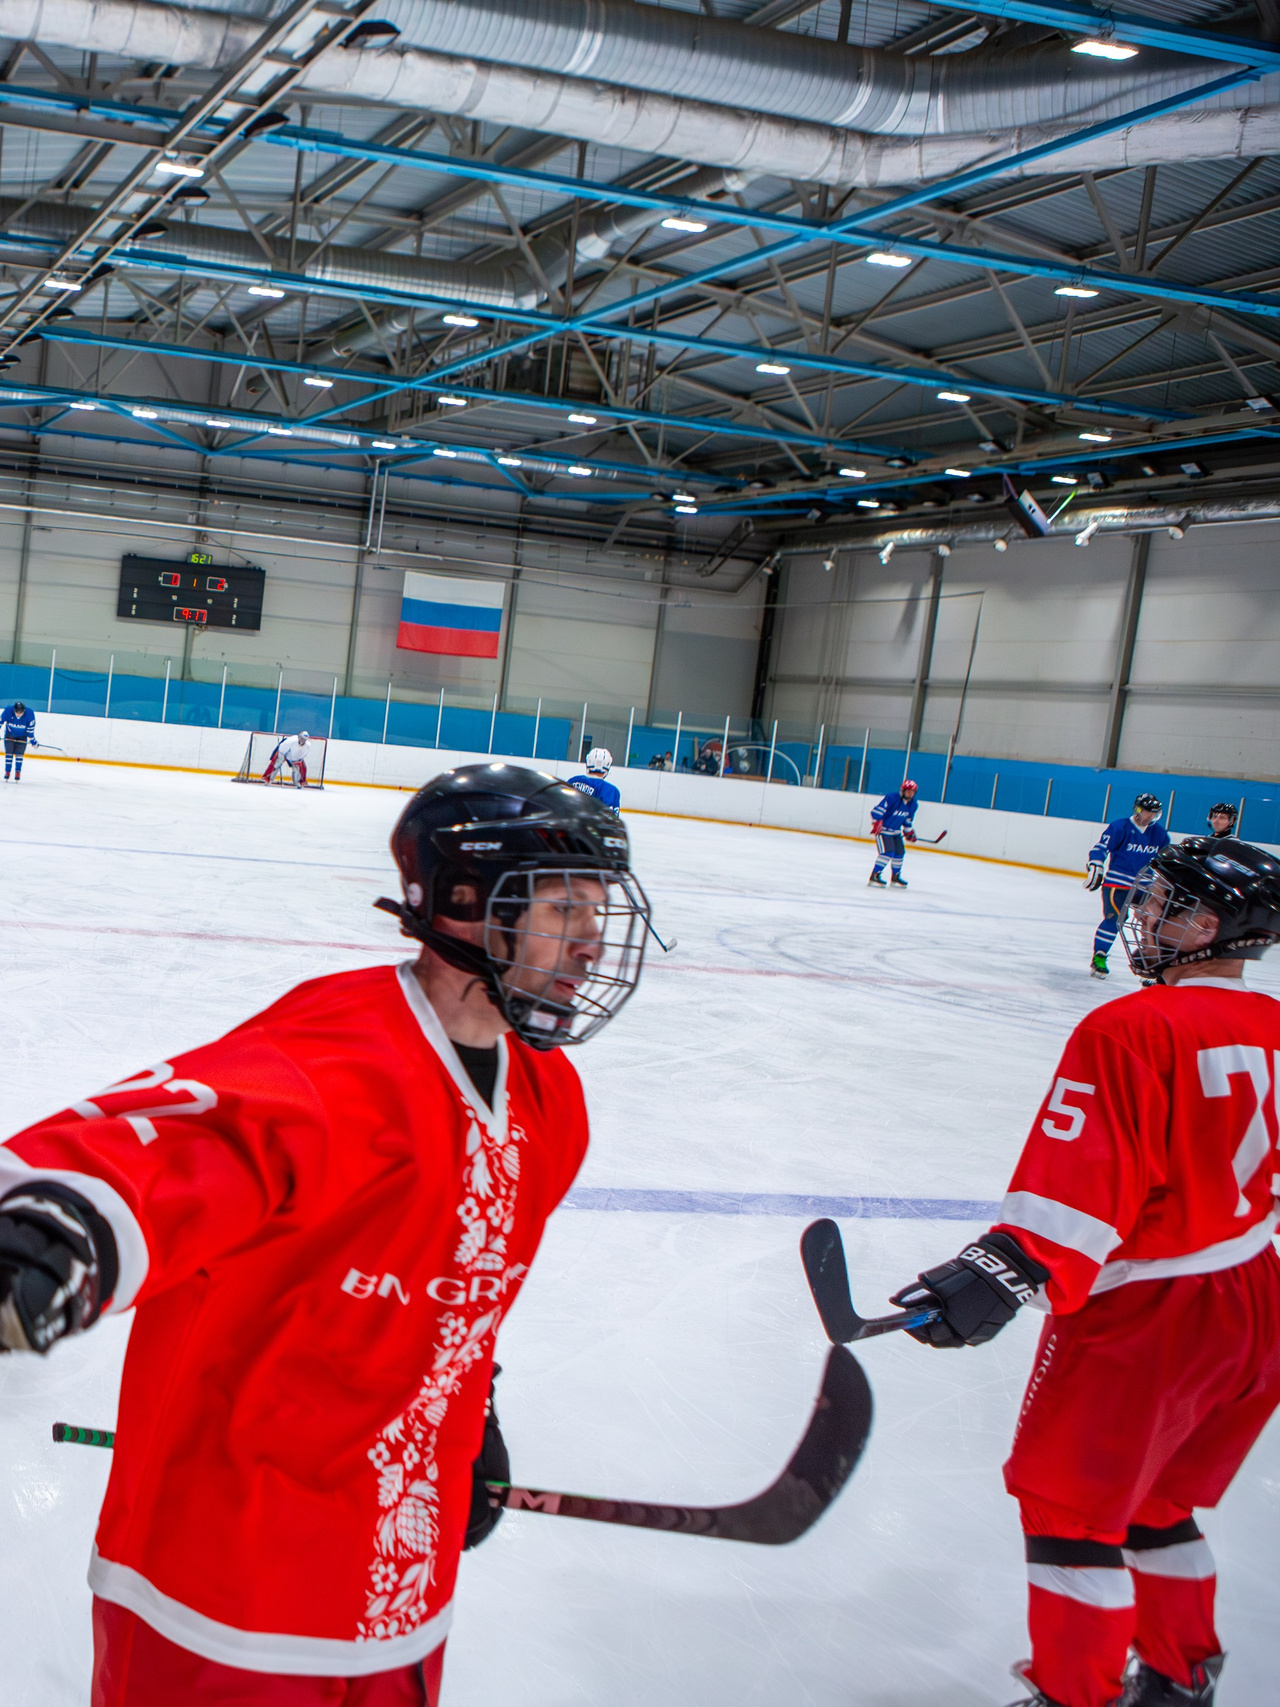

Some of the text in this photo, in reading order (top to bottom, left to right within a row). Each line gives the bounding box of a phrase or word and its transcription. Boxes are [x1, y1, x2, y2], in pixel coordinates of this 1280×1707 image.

[171, 573, 180, 586] 0
[216, 578, 226, 591] 2
[181, 607, 207, 623] 9:17
[459, 841, 503, 851] CCM
[1041, 1076, 1096, 1142] 5
[1197, 1043, 1280, 1219] 7
[340, 1267, 411, 1306] BN
